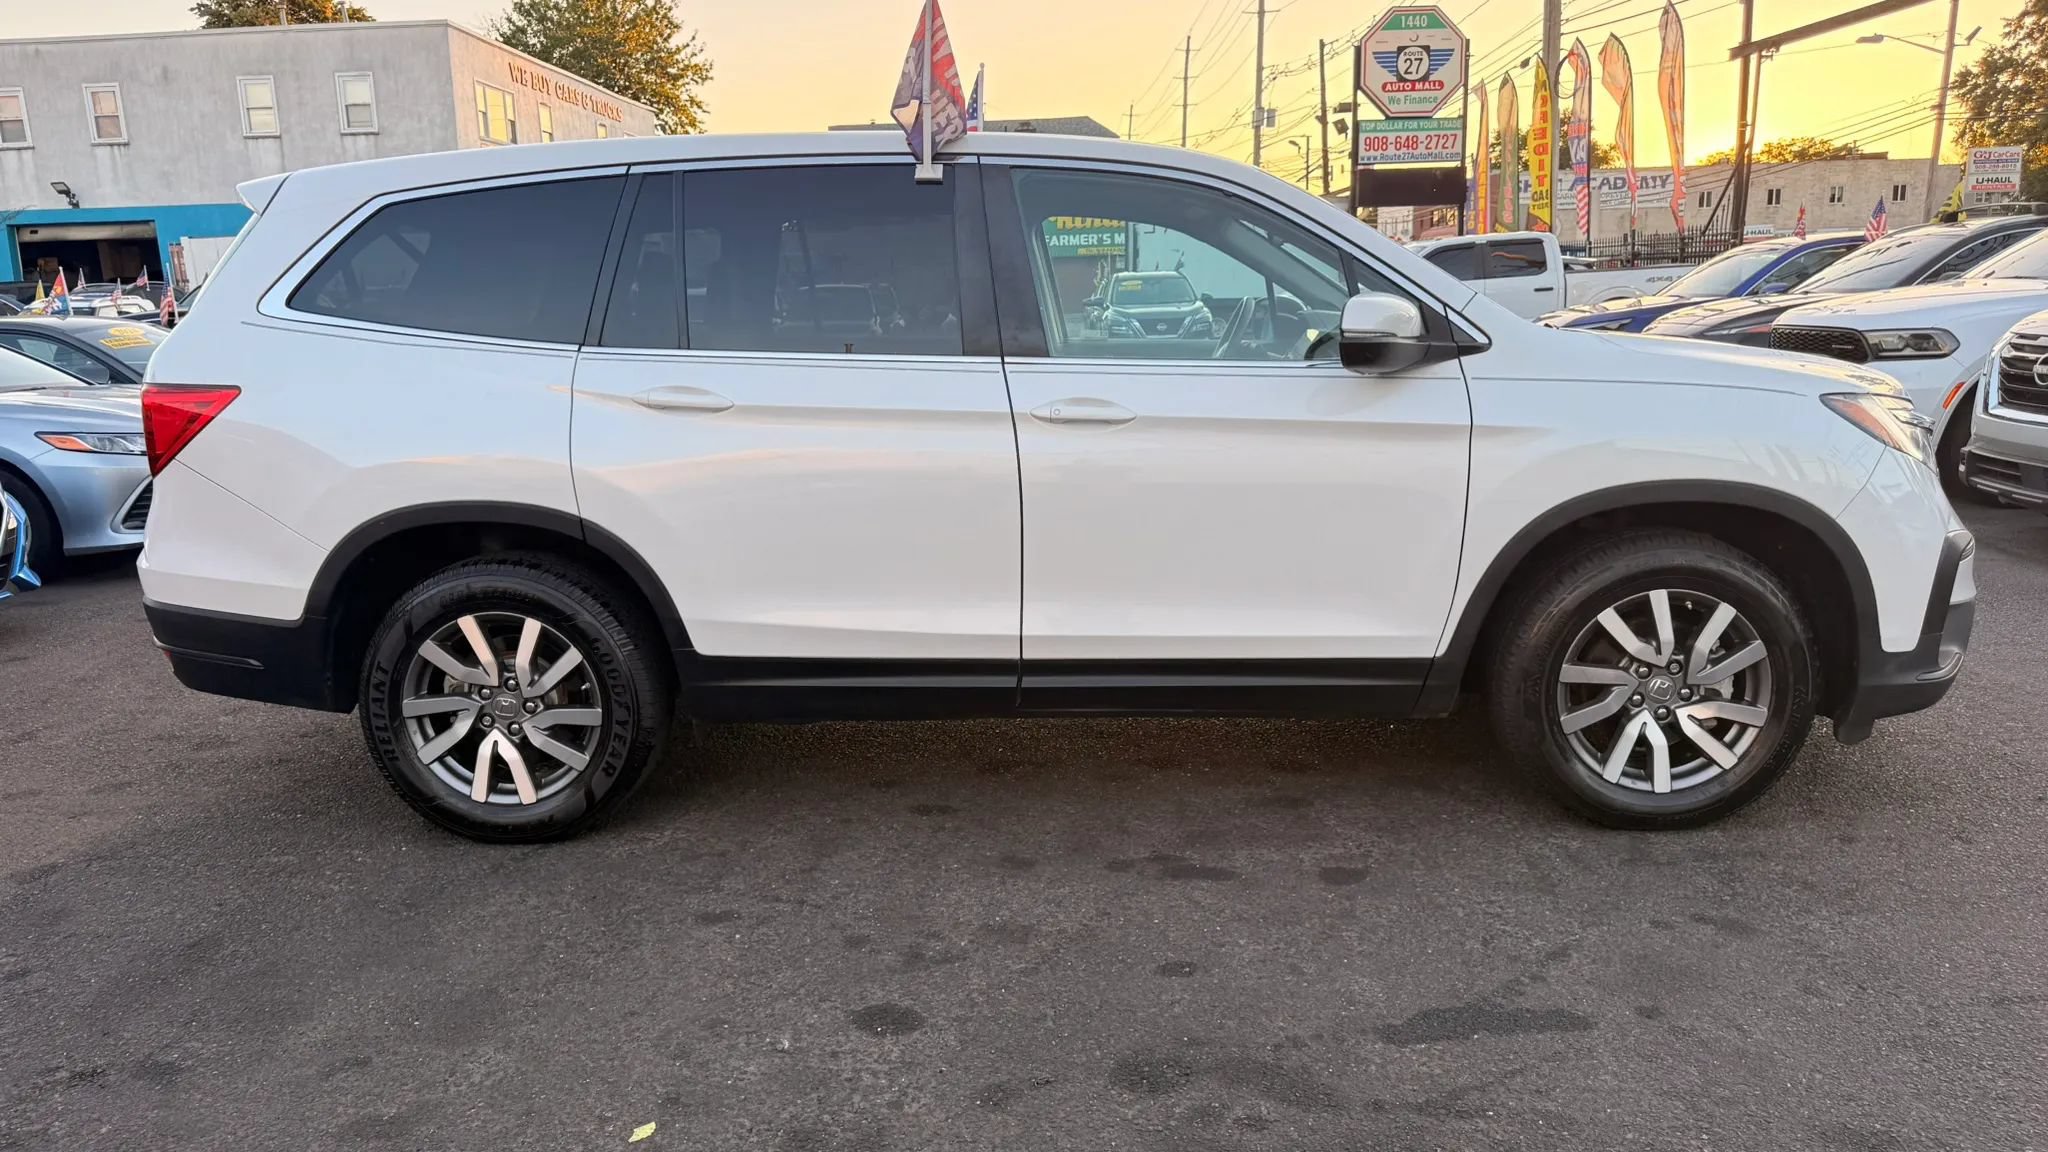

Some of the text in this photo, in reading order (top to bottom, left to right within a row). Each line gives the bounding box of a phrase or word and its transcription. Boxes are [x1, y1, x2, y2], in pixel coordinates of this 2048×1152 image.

[1401, 15, 1428, 28] 1440
[1403, 58, 1423, 75] 27
[508, 62, 528, 87] WE
[530, 71, 551, 95] BUY
[555, 80, 580, 105] CARS
[590, 95, 623, 122] TRUCKS
[1385, 81, 1441, 91] AUTO MALL
[1387, 94, 1438, 105] We Finance
[1362, 119, 1461, 130] TOP DOLLAR FOR YOUR TRADE
[1364, 133, 1458, 152] 908-648-2727
